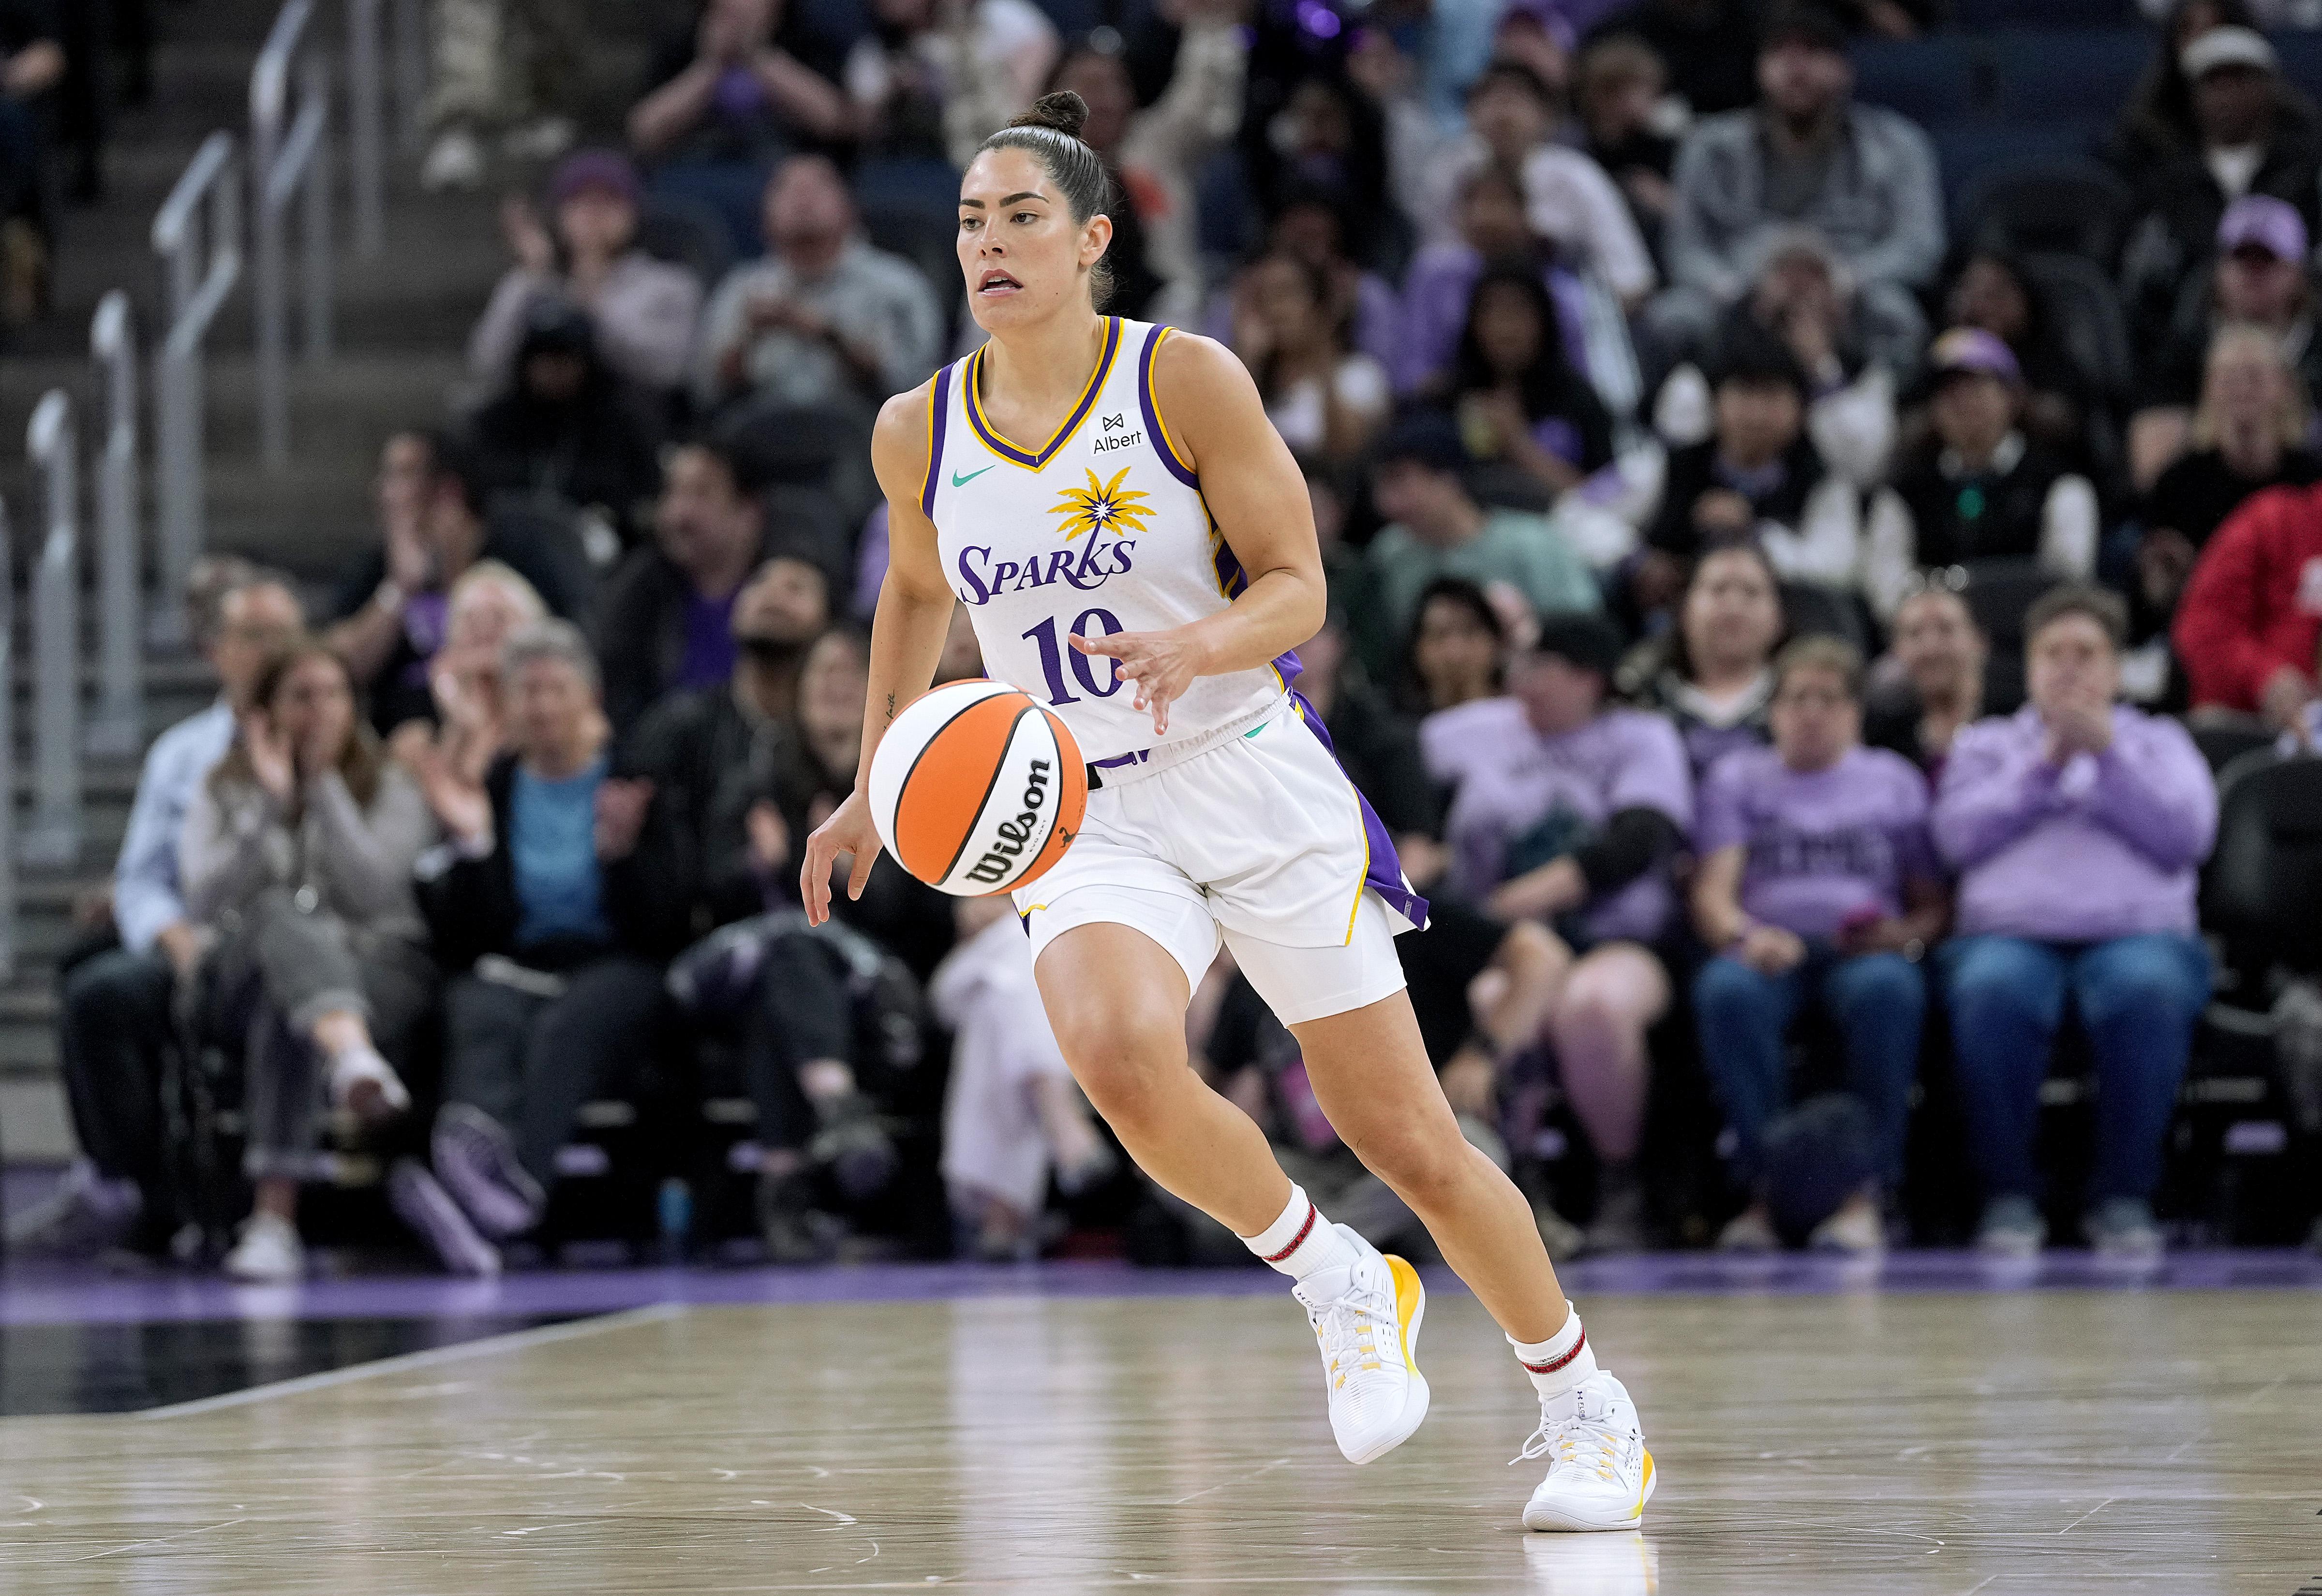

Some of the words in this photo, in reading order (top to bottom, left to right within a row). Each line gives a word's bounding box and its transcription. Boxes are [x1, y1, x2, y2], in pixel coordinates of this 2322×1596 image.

[1093, 430, 1142, 454] Albert
[1022, 608, 1125, 706] 10
[962, 757, 1051, 884] Wilson
[1029, 838, 1039, 852] EVO
